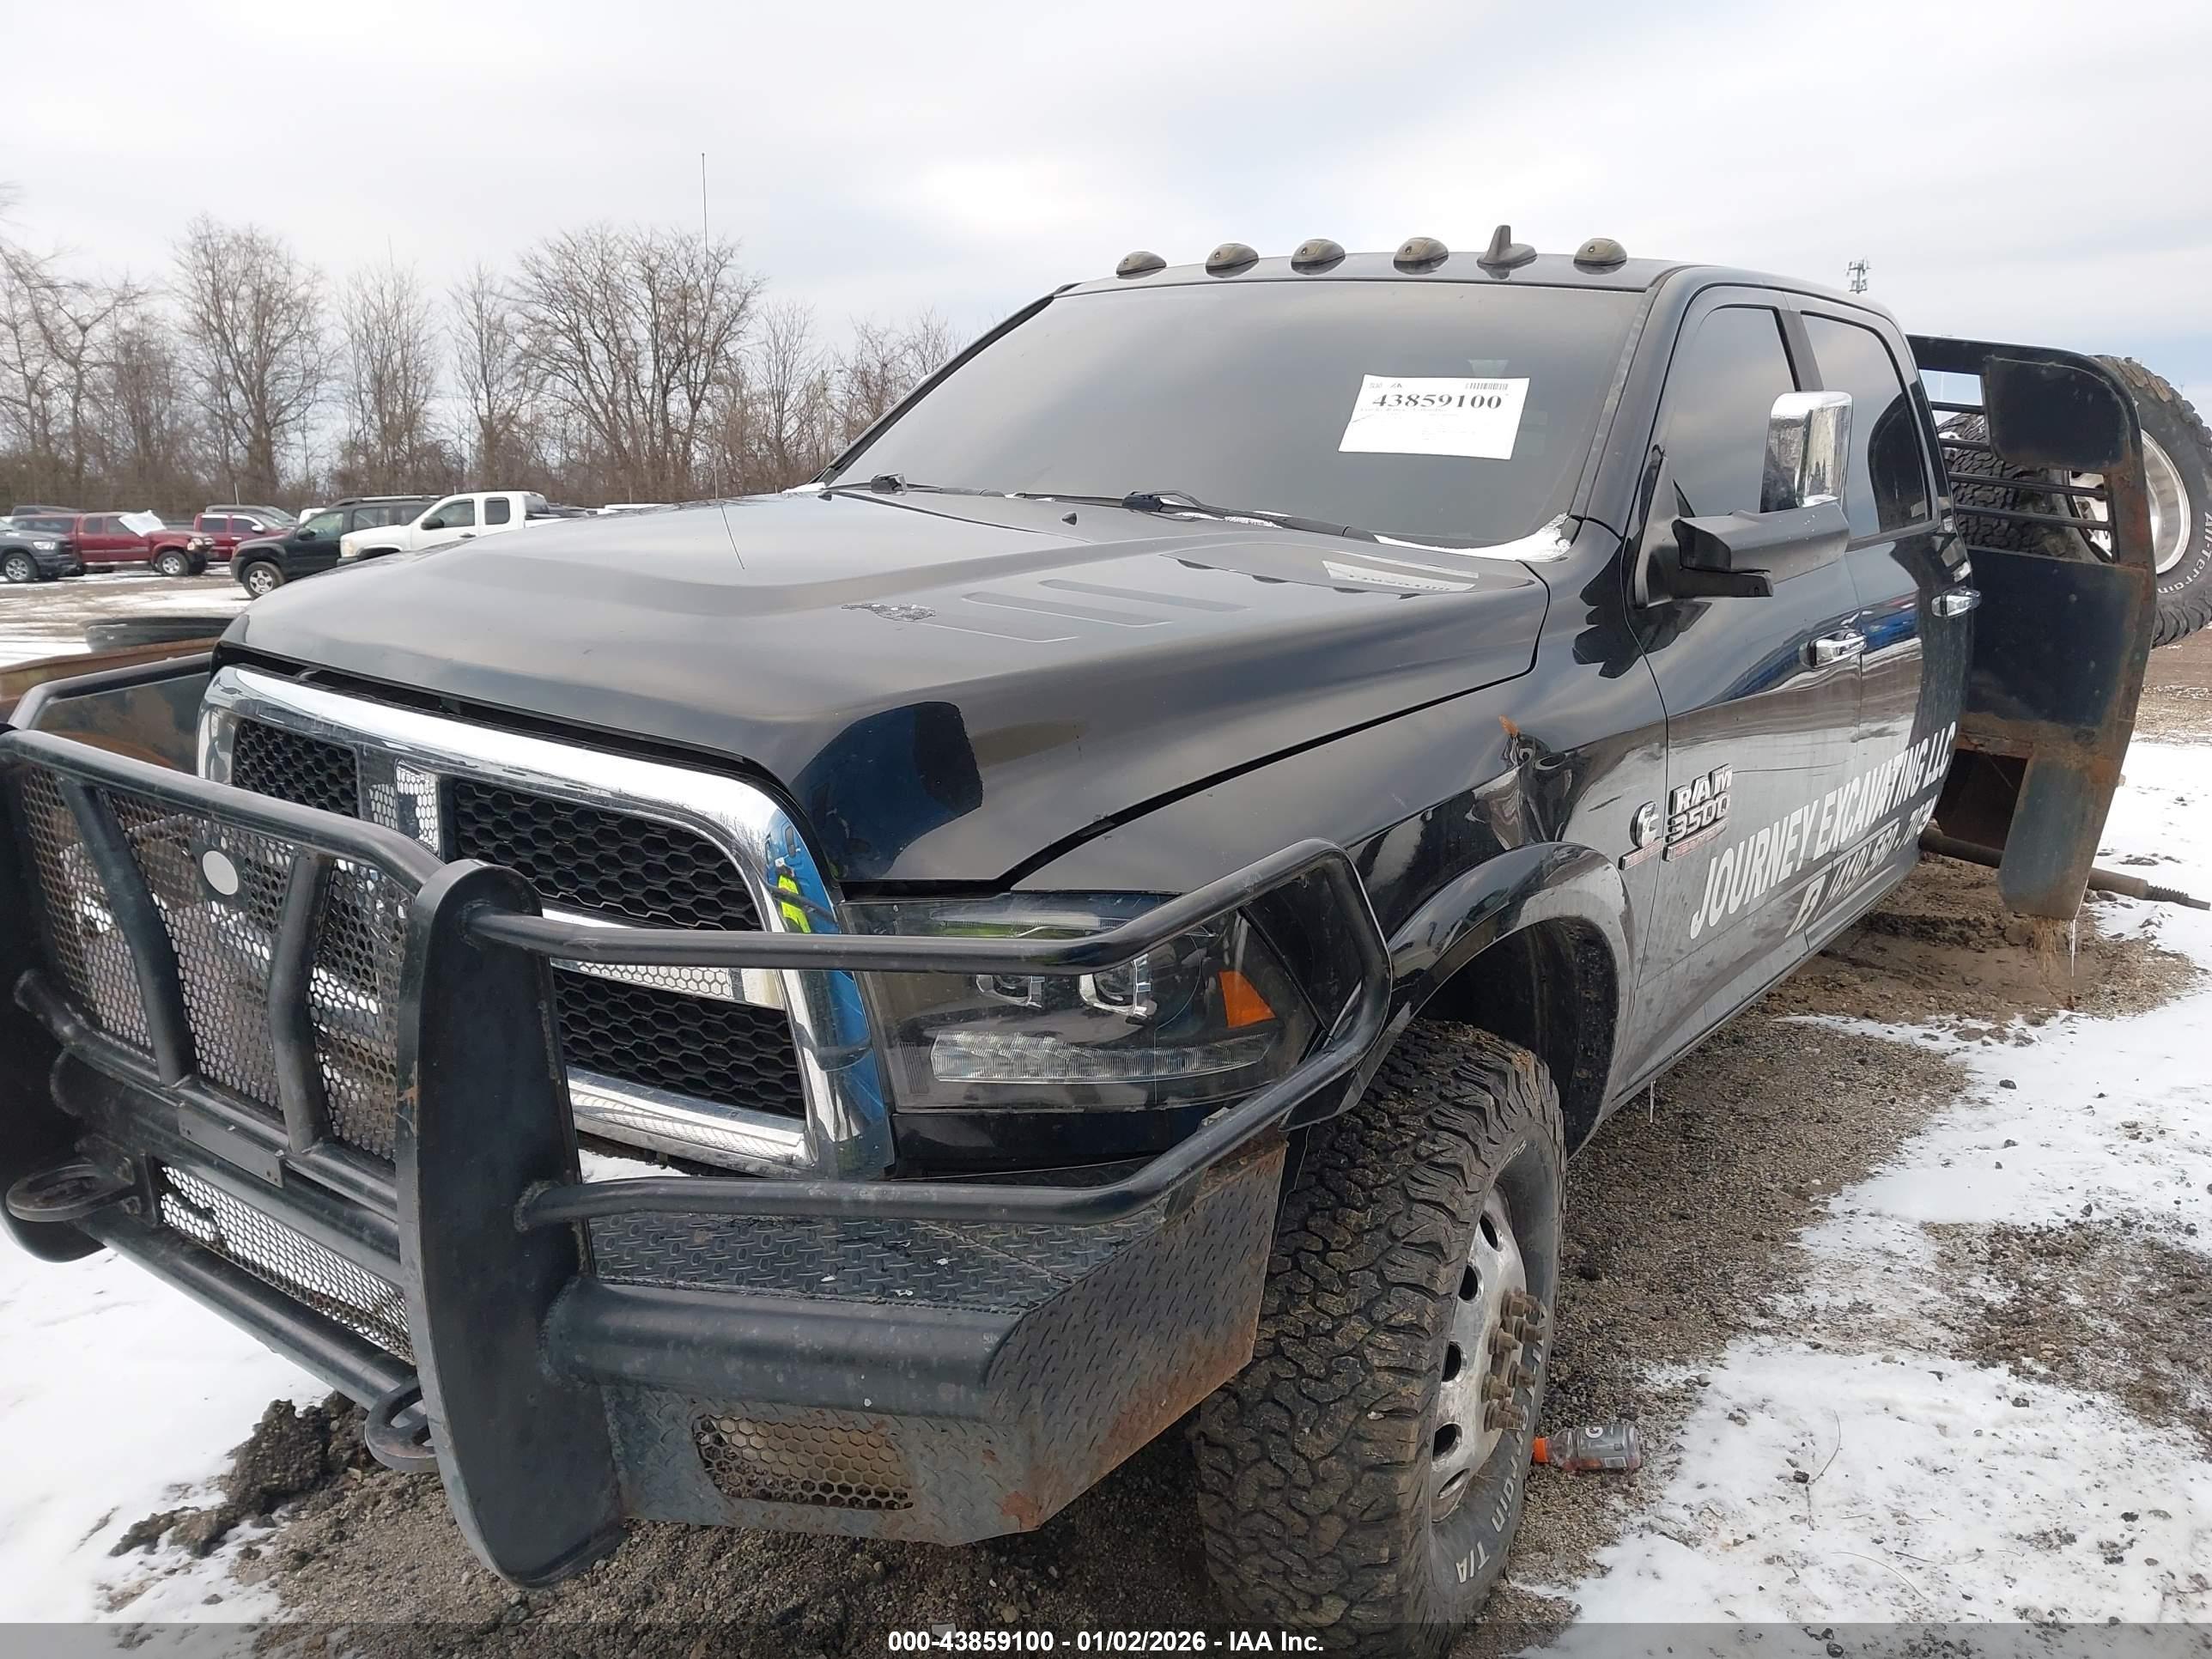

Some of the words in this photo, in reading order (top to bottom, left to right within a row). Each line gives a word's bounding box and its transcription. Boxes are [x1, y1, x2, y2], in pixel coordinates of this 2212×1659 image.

[1373, 393, 1503, 409] 43859100
[1669, 764, 1733, 815] RAM
[1668, 791, 1730, 843] 3500
[1689, 799, 1820, 939] JOURNEY
[1813, 738, 1929, 862] EXCAVATING
[1922, 720, 1956, 789] LLC
